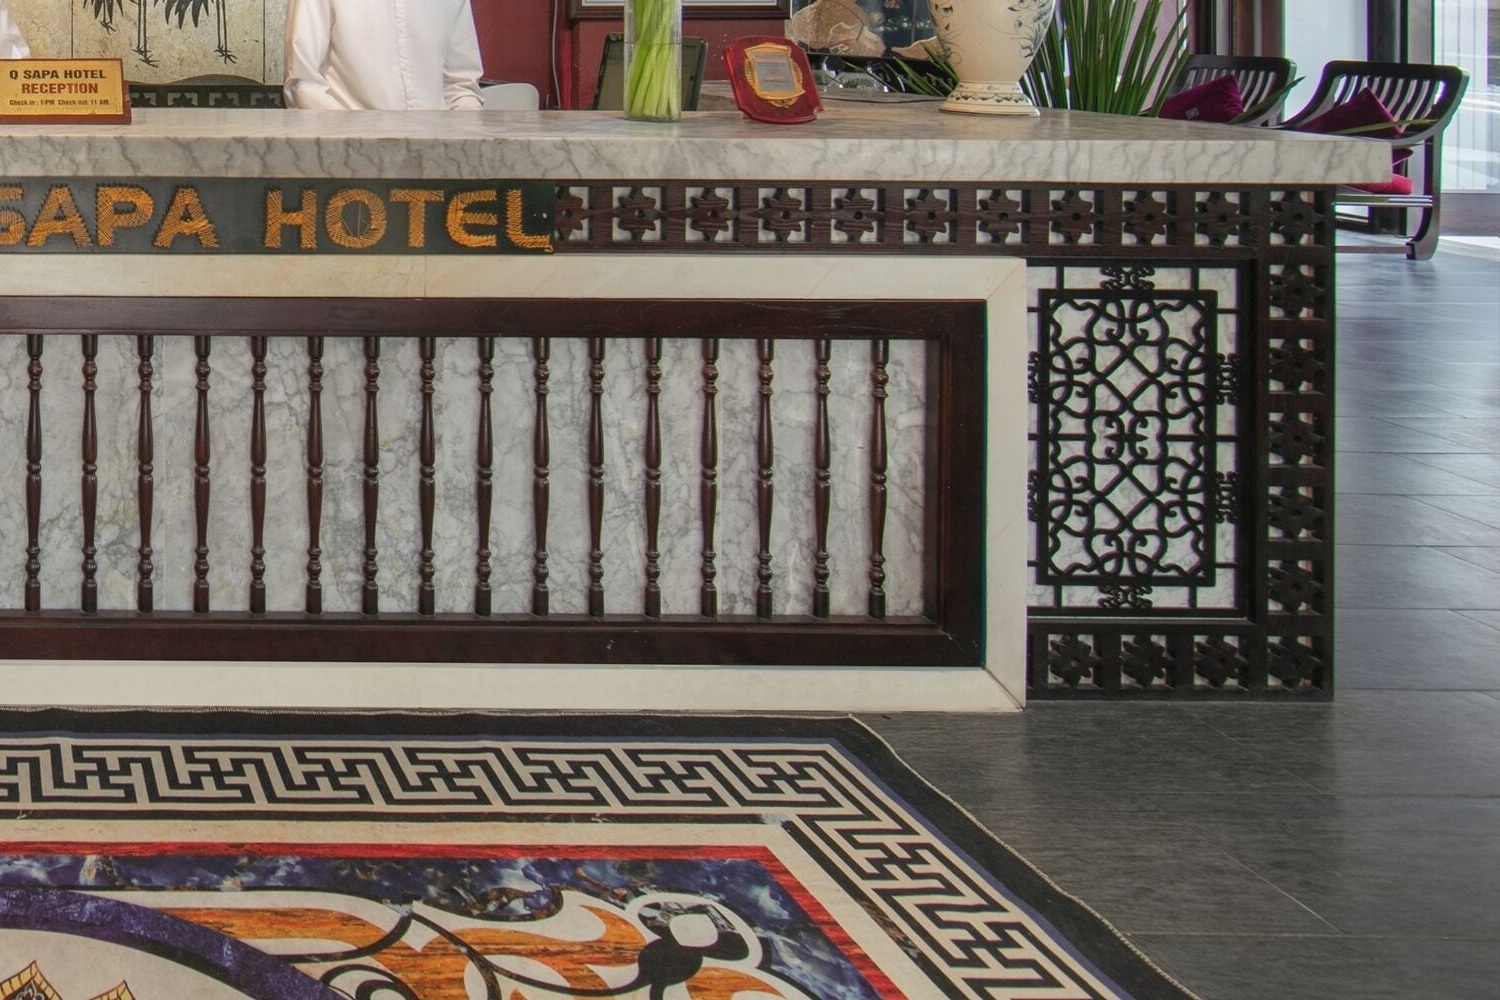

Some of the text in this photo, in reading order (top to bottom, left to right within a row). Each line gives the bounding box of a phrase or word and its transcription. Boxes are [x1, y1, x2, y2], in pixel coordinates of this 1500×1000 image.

[9, 69, 107, 80] Q SAPA HOTEL
[21, 83, 99, 94] RECEPTION
[263, 187, 553, 251] HOTEL
